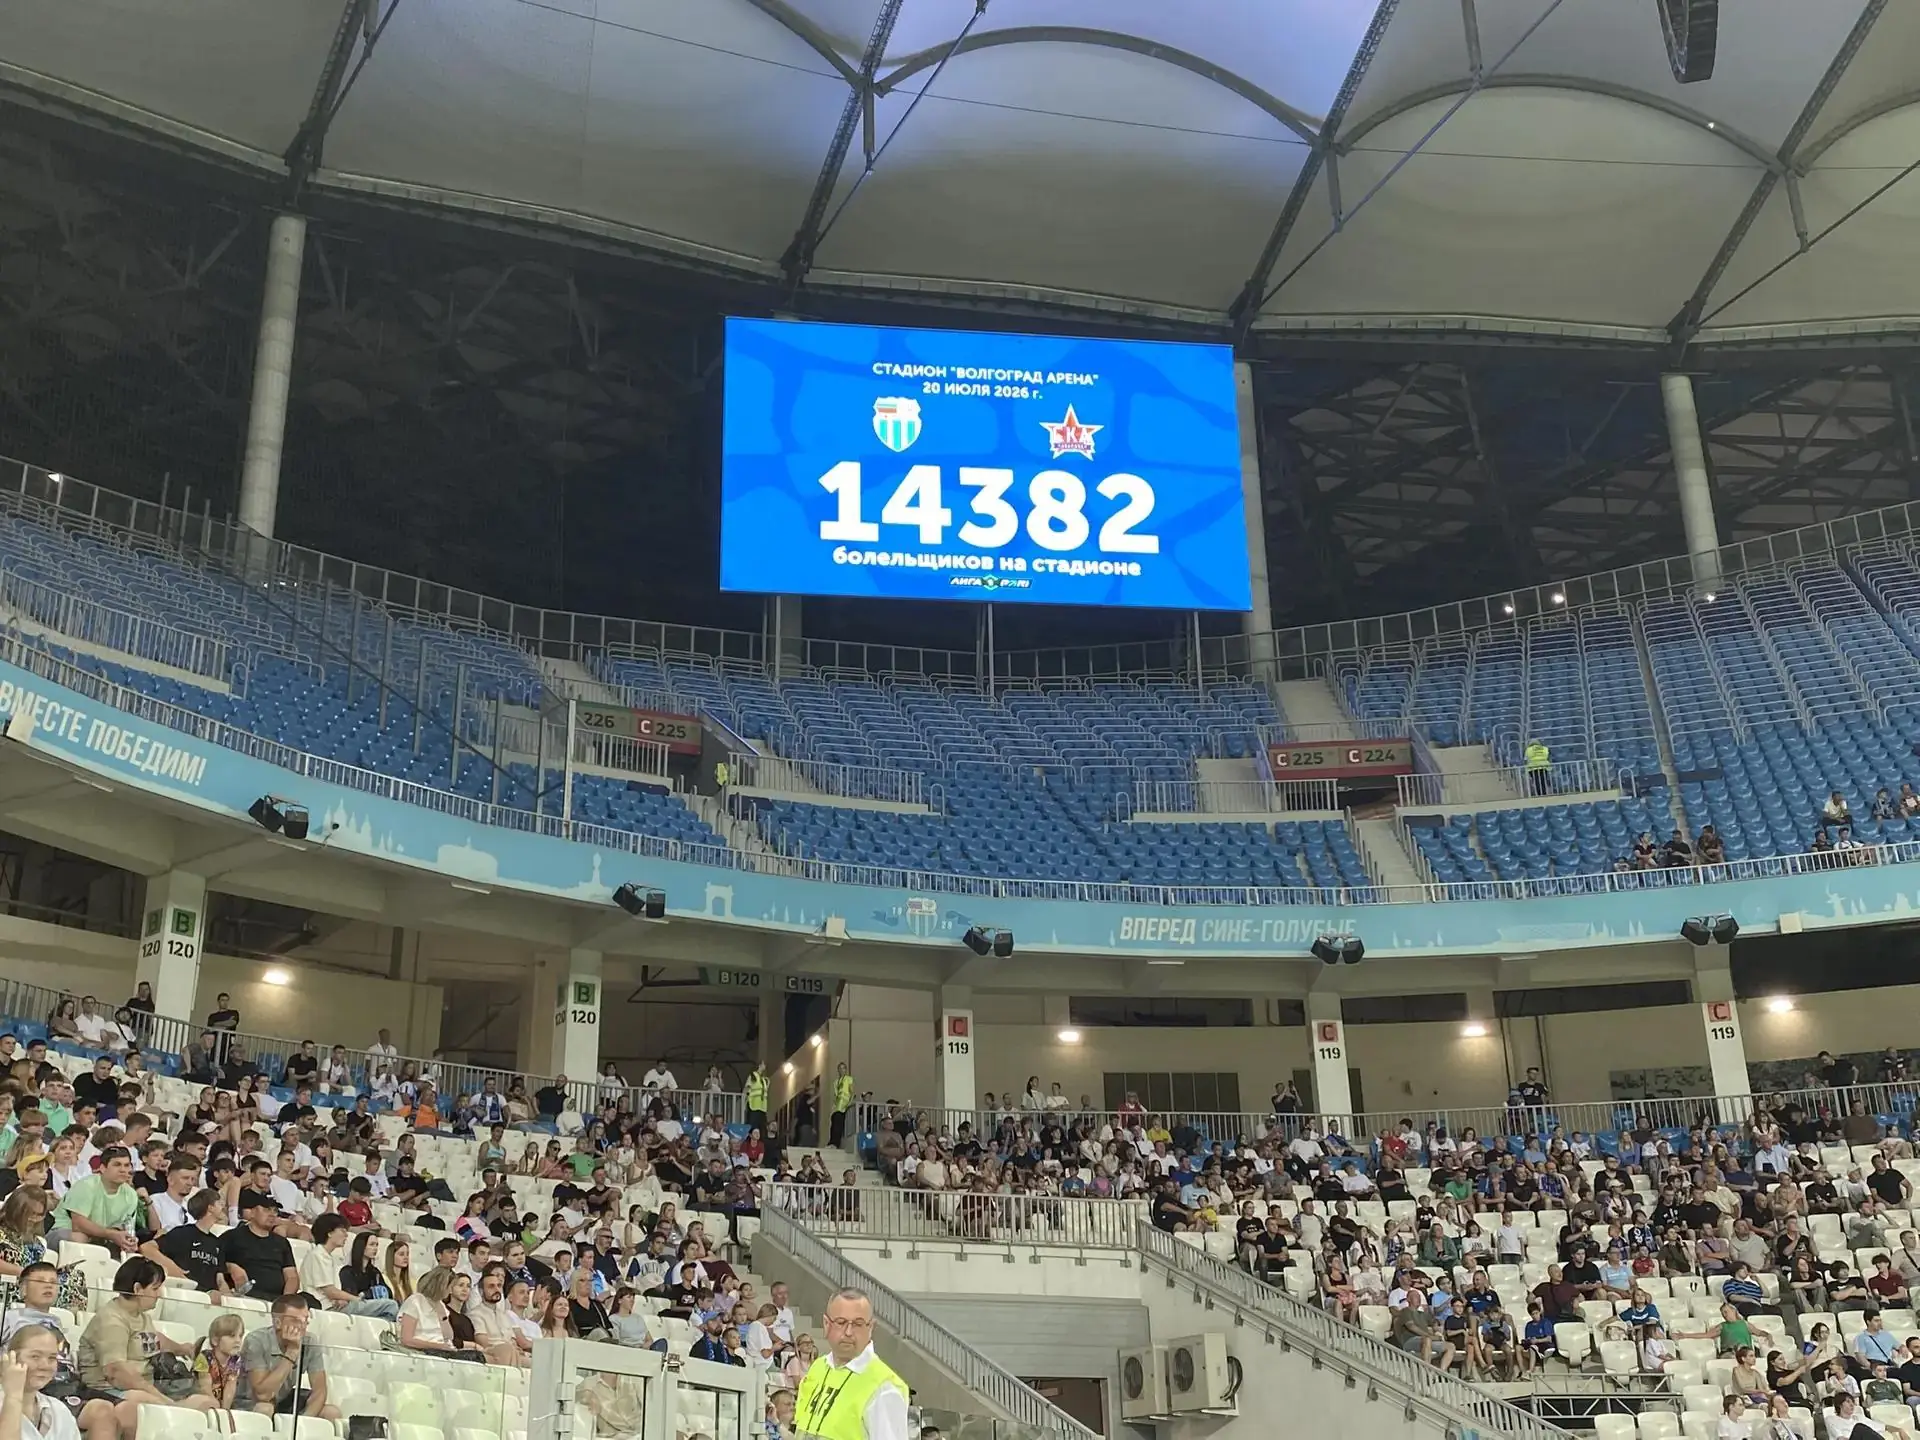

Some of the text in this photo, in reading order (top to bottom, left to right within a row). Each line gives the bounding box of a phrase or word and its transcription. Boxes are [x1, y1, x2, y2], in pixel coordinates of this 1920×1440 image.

[872, 362, 1099, 386] СТАДИОН "ВОЛГОГРАД АРЕНА"
[923, 382, 940, 394] 20
[945, 383, 990, 397] ИЮЛЯ
[994, 386, 1029, 399] 2026
[818, 461, 1159, 554] 14382
[832, 545, 1142, 577] болельщиков на стадионе
[950, 576, 982, 586] ЛИГА
[583, 711, 687, 739] 226 C 225
[85, 718, 207, 786] ПОБЕДИМ!
[1276, 748, 1396, 766] C 225 C 224
[176, 911, 190, 933] B
[1119, 917, 1197, 944] ВПЕРЕД
[142, 939, 161, 958] 120
[167, 940, 194, 958] 120
[721, 971, 823, 992] B 120 C 119
[577, 984, 590, 1003] B
[571, 1010, 597, 1025] 120
[1713, 1003, 1728, 1019] C
[952, 1019, 965, 1035] C
[1322, 1024, 1335, 1041] C
[1711, 1026, 1735, 1040] 119
[948, 1041, 969, 1054] 119
[1319, 1047, 1341, 1060] 119
